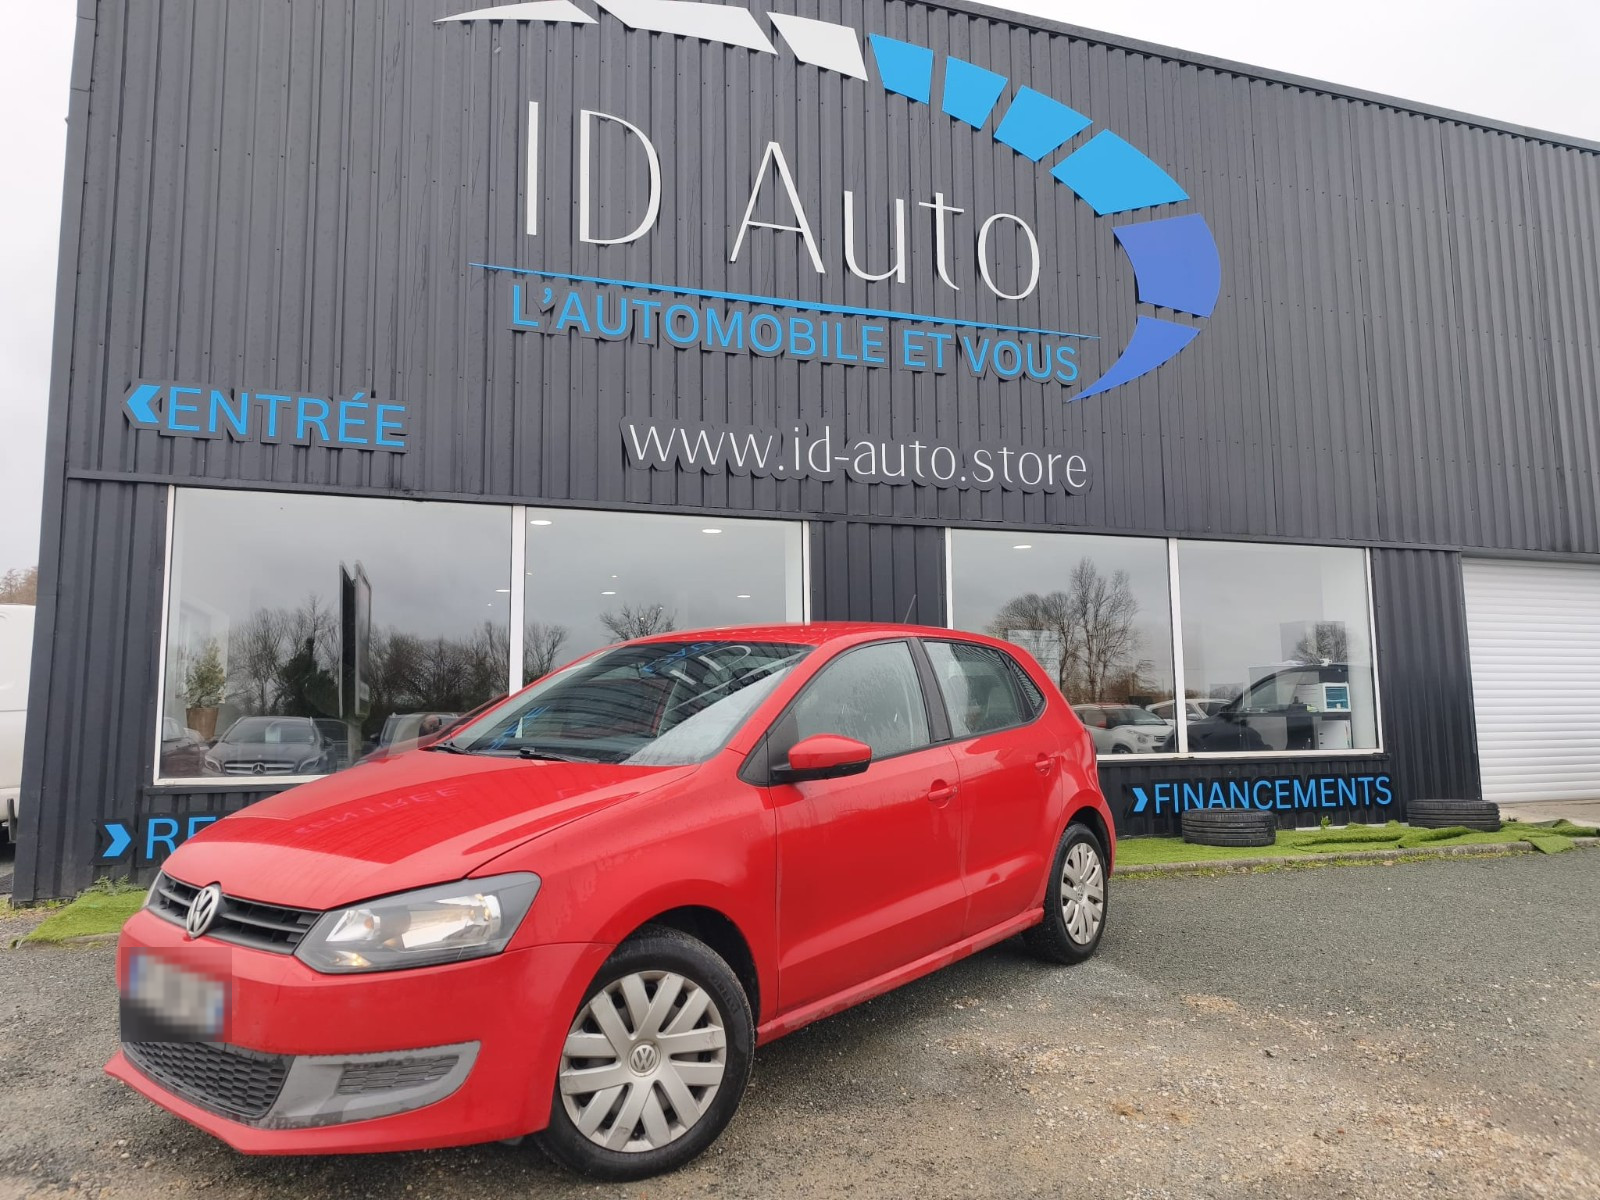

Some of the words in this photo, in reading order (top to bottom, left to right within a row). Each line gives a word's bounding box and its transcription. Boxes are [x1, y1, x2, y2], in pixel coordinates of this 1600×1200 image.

[525, 100, 661, 246] ID
[730, 140, 1041, 301] Auto
[511, 283, 886, 365] L'AUTOMOBILE
[902, 329, 952, 369] ET
[963, 337, 1079, 382] VOUS
[167, 385, 406, 448] ENTRÉE
[628, 424, 1088, 489] www.id-auto.store
[1154, 775, 1393, 814] FINANCEMENTS
